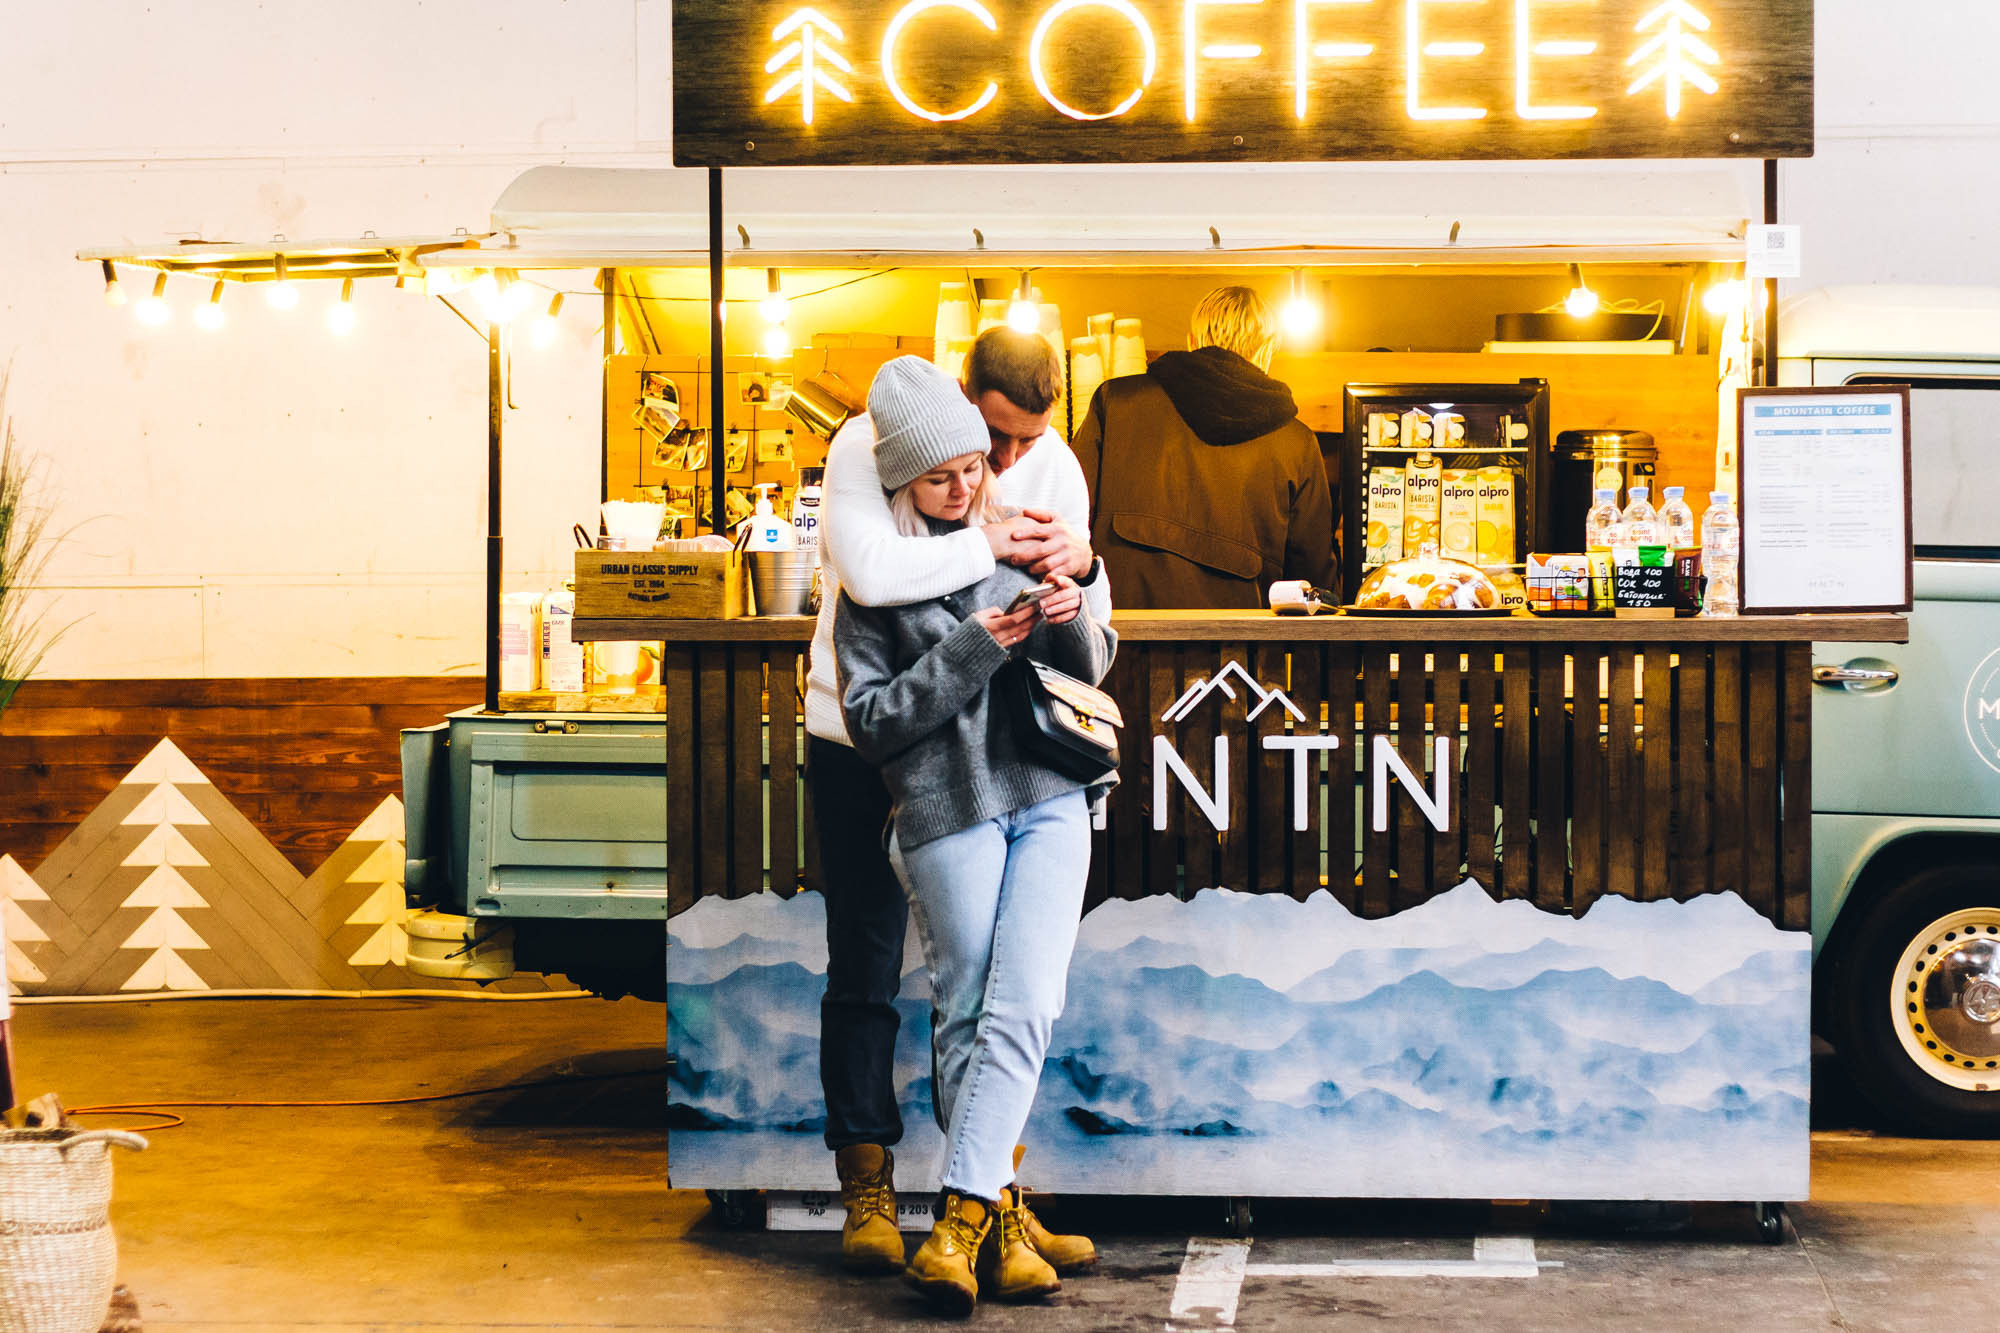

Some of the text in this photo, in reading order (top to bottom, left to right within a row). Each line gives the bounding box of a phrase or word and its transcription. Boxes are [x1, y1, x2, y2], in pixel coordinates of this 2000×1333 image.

[879, 0, 1599, 123] COFFEE
[1773, 406, 1876, 416] MOUNTAIN COFFEE
[1407, 474, 1439, 490] alpro
[1371, 483, 1402, 498] alpro
[1443, 485, 1475, 500] alpro
[1478, 485, 1510, 500] alpro
[1410, 494, 1435, 503] BARISTA
[794, 512, 819, 531] alp
[797, 535, 818, 545] BARIS
[600, 564, 699, 576] URBAN CLASSIC SUPPLY
[1644, 568, 1663, 576] 100
[1642, 579, 1662, 588] 100
[1501, 593, 1524, 606] lpro
[1092, 734, 1451, 833] NTN
[808, 1208, 826, 1217] PAP
[908, 1204, 929, 1215] 203
